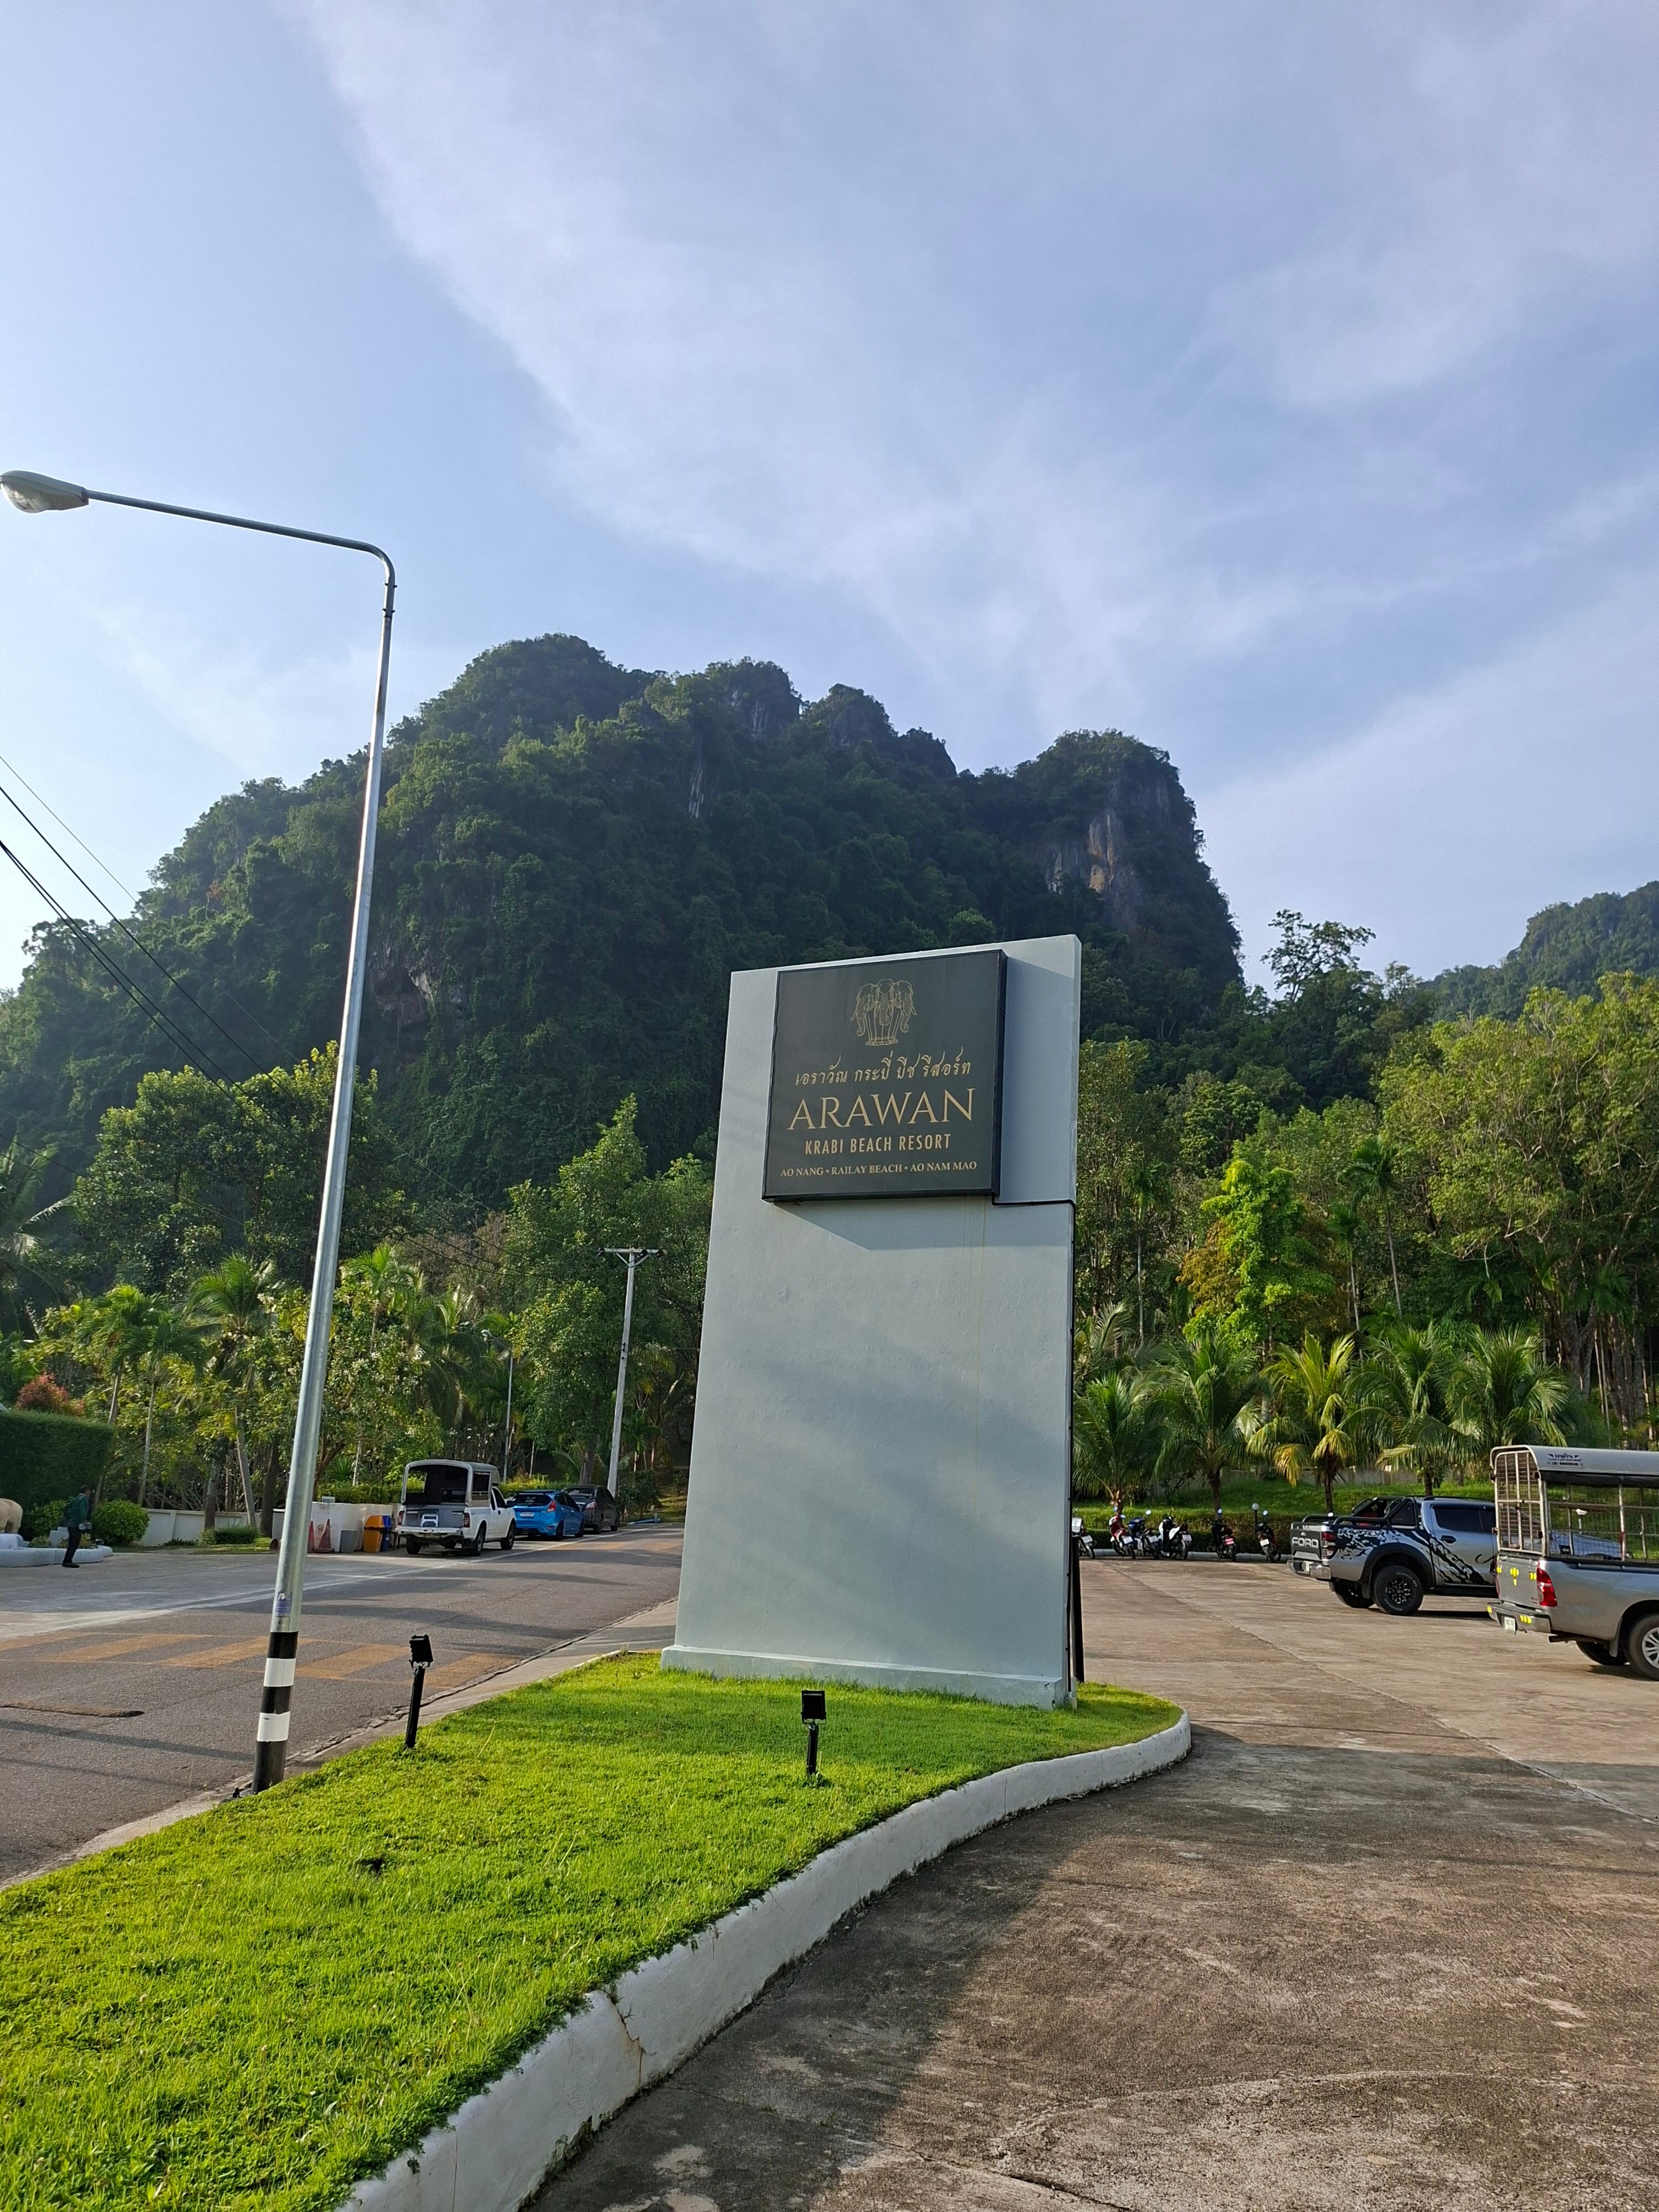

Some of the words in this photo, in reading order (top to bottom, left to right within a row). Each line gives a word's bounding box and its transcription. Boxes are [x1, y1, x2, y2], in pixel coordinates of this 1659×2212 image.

[795, 1054, 848, 1086] เอราวัณ
[854, 1050, 894, 1082] กระบี่
[897, 1052, 921, 1079] บีช
[921, 1045, 971, 1078] รีสอร์ท
[786, 1088, 976, 1130] ARAWAN
[805, 1139, 843, 1155] KRABI
[850, 1136, 891, 1153] BEACH
[899, 1133, 951, 1151] RESORT
[780, 1168, 794, 1177] AO
[796, 1167, 824, 1176] NANG
[831, 1165, 867, 1175] RAILAY
[869, 1164, 902, 1173] BEACH
[910, 1163, 925, 1172] AO
[926, 1162, 951, 1171] NAM
[952, 1161, 977, 1171] MAO
[1292, 1537, 1319, 1548] FORD
[1338, 1528, 1386, 1539] RAPTOR
